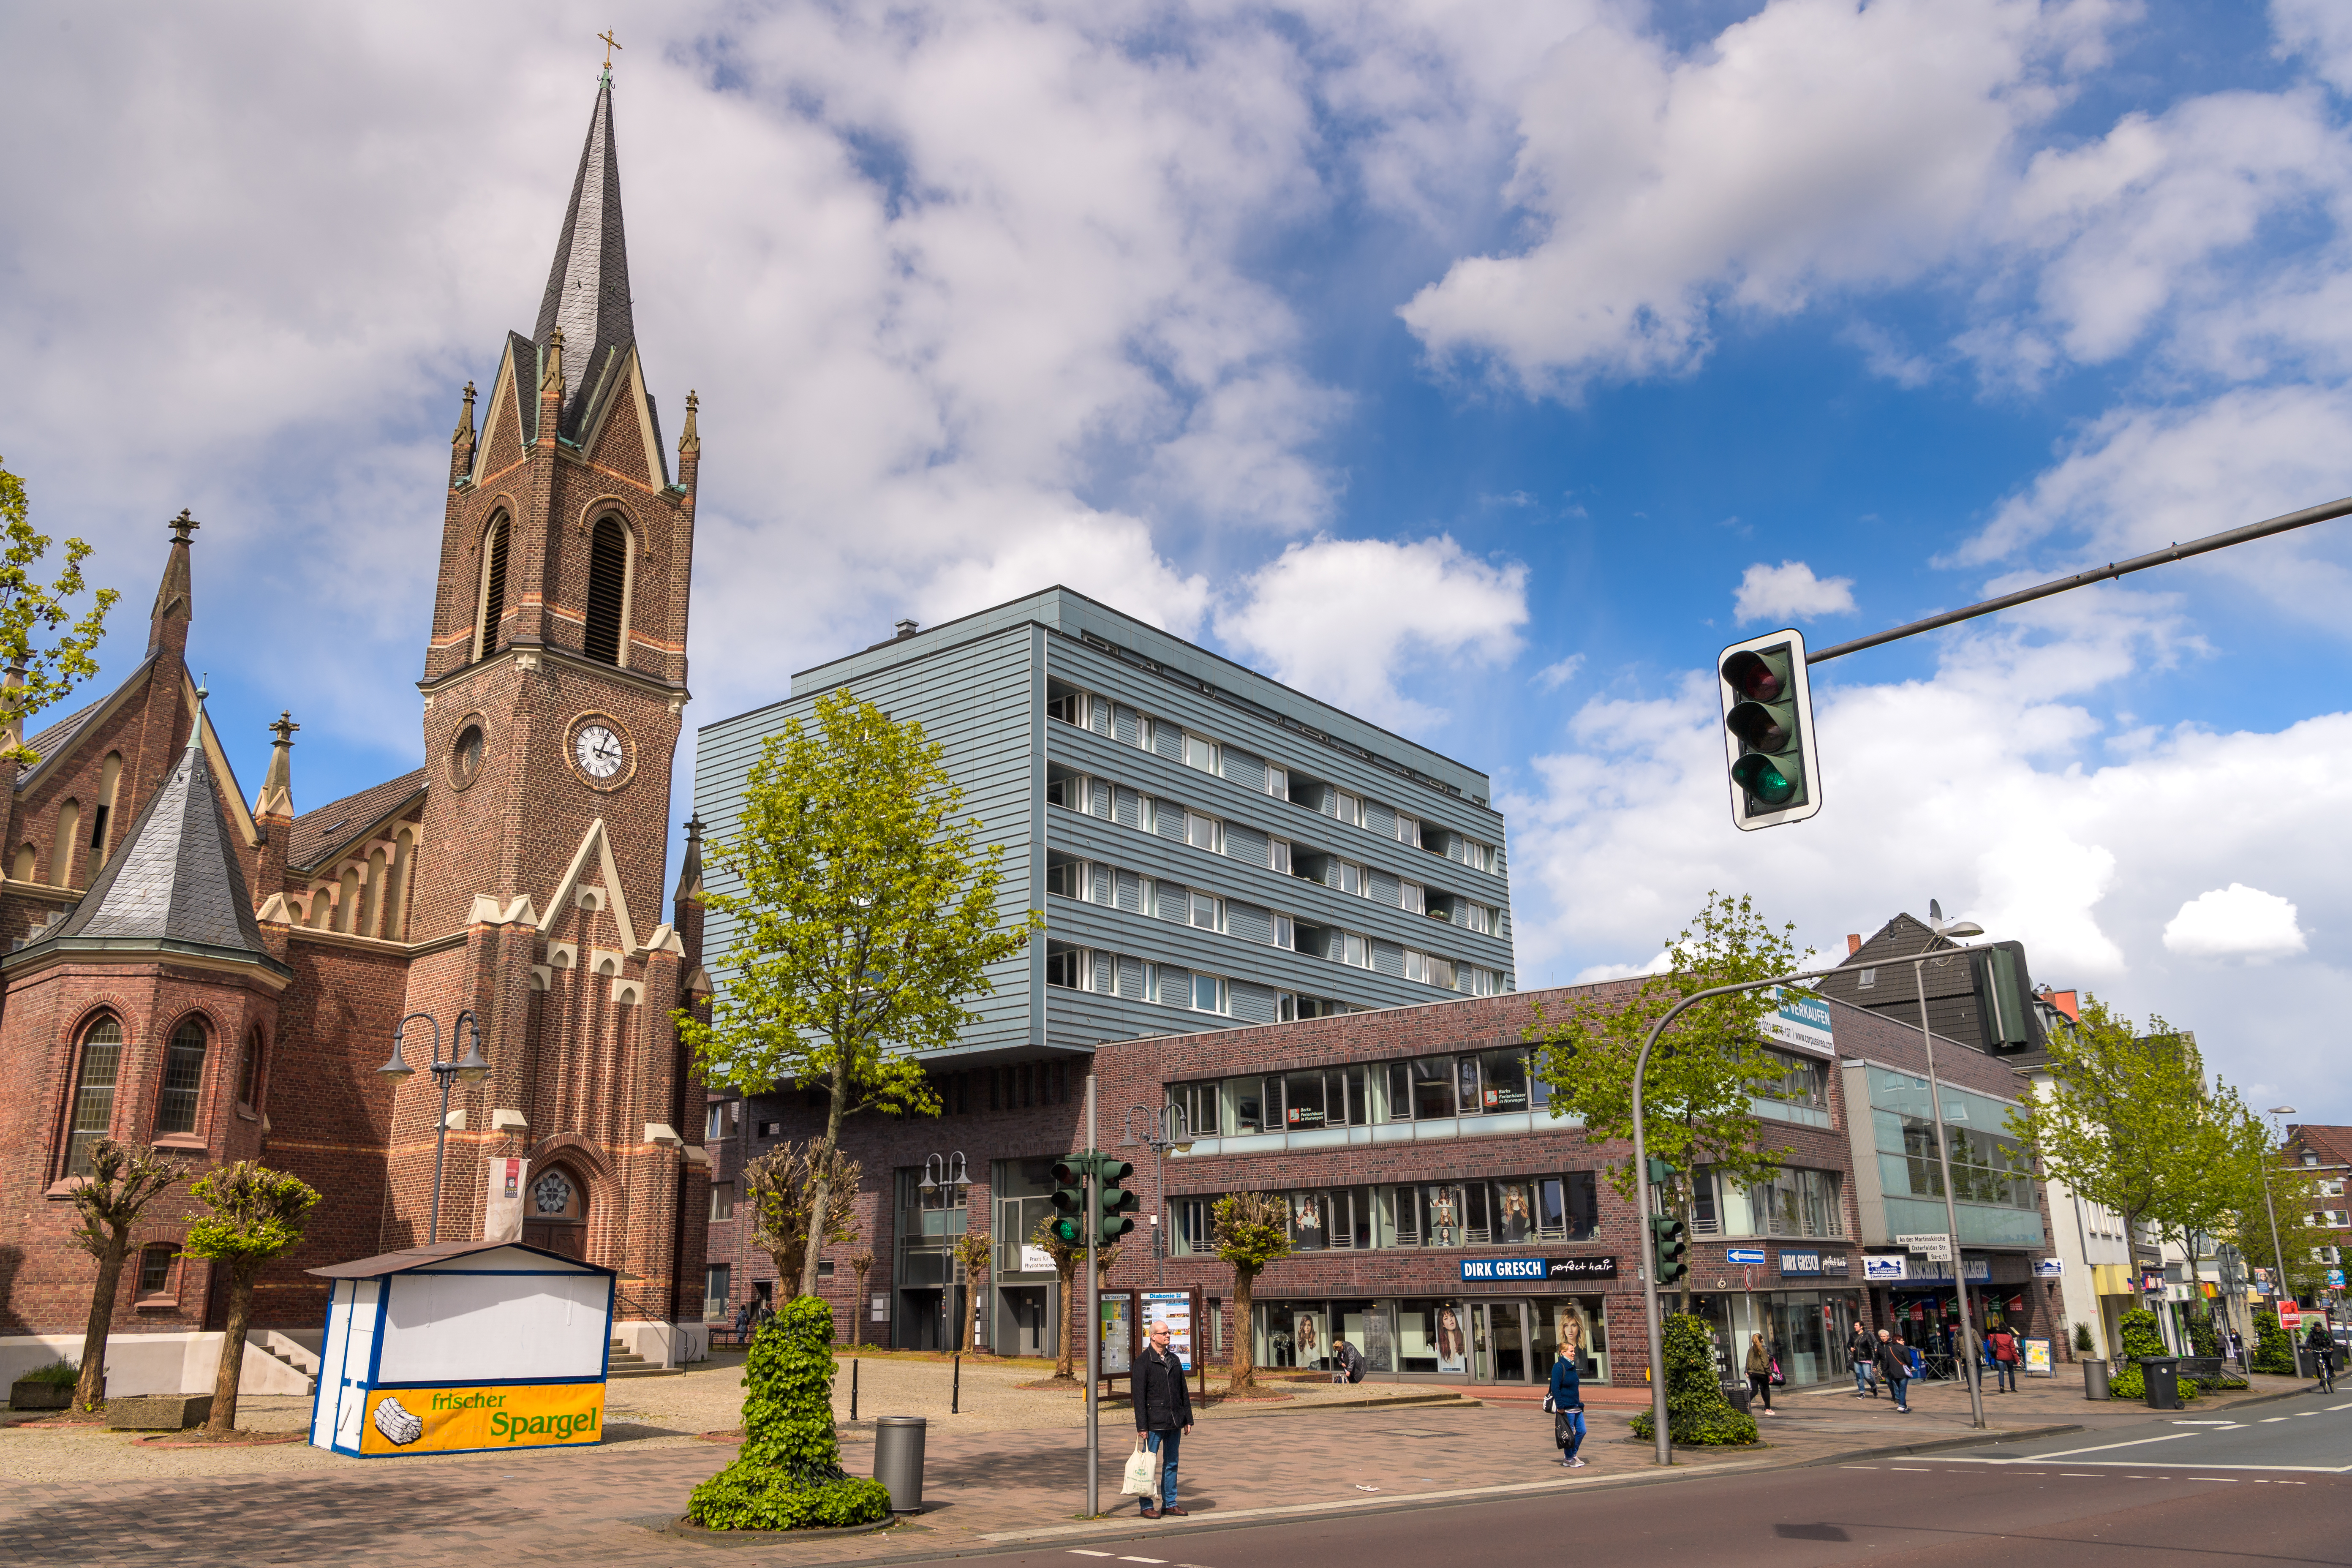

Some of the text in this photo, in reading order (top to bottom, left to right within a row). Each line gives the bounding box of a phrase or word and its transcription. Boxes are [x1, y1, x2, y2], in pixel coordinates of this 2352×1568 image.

[1790, 1002, 1830, 1026] VERKAUFEN
[1795, 1032, 1833, 1051] www.corpussireo.com
[1465, 1259, 1613, 1277] DIRK GRESCH perfect hair
[1782, 1255, 1847, 1271] DIRK GRESCH perfect hair
[1906, 1260, 1939, 1279] NISCHES
[432, 1392, 506, 1410] frischer
[491, 1407, 596, 1442] Spargel
